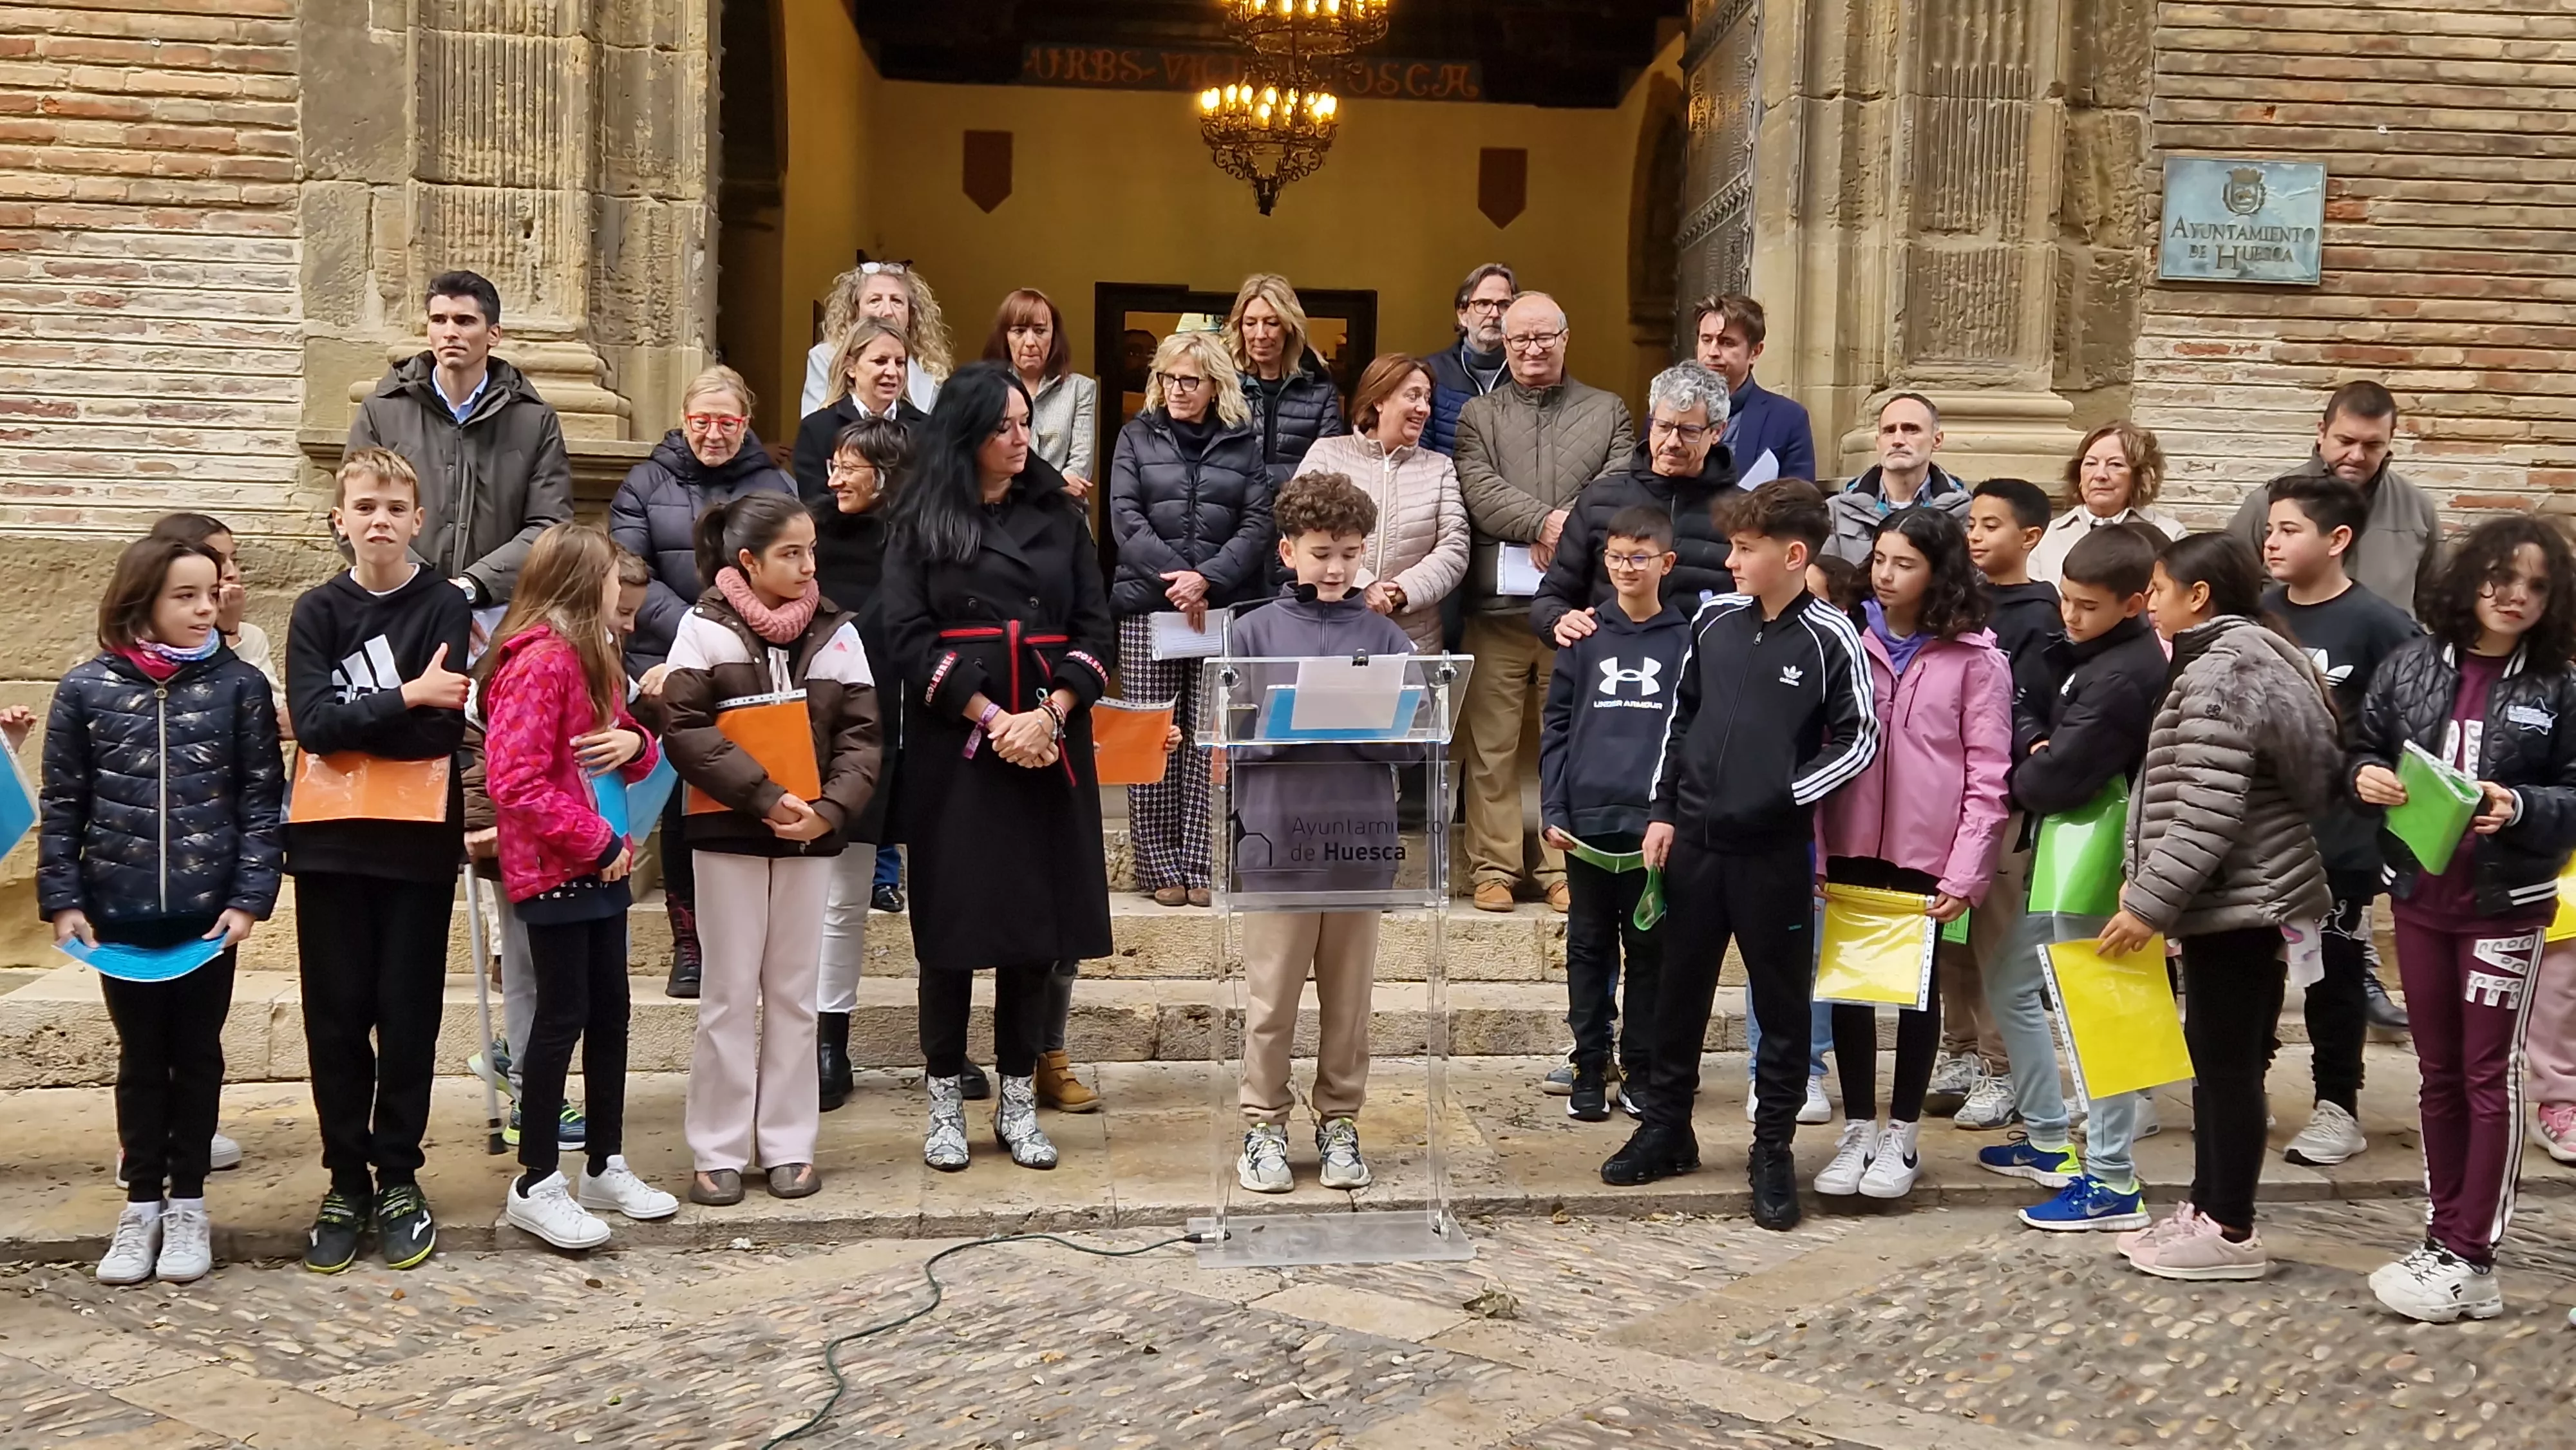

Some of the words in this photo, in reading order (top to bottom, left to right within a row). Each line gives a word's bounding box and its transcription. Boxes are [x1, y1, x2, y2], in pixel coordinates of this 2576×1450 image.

[2170, 215, 2316, 243] AYUNTAMIENTO
[2188, 244, 2207, 259] DE
[2215, 244, 2294, 270] HUESCA
[1594, 699, 1623, 708] UNDER
[1623, 700, 1663, 710] ARMOUR
[1291, 842, 1315, 862] de
[1324, 842, 1406, 862] Huesca
